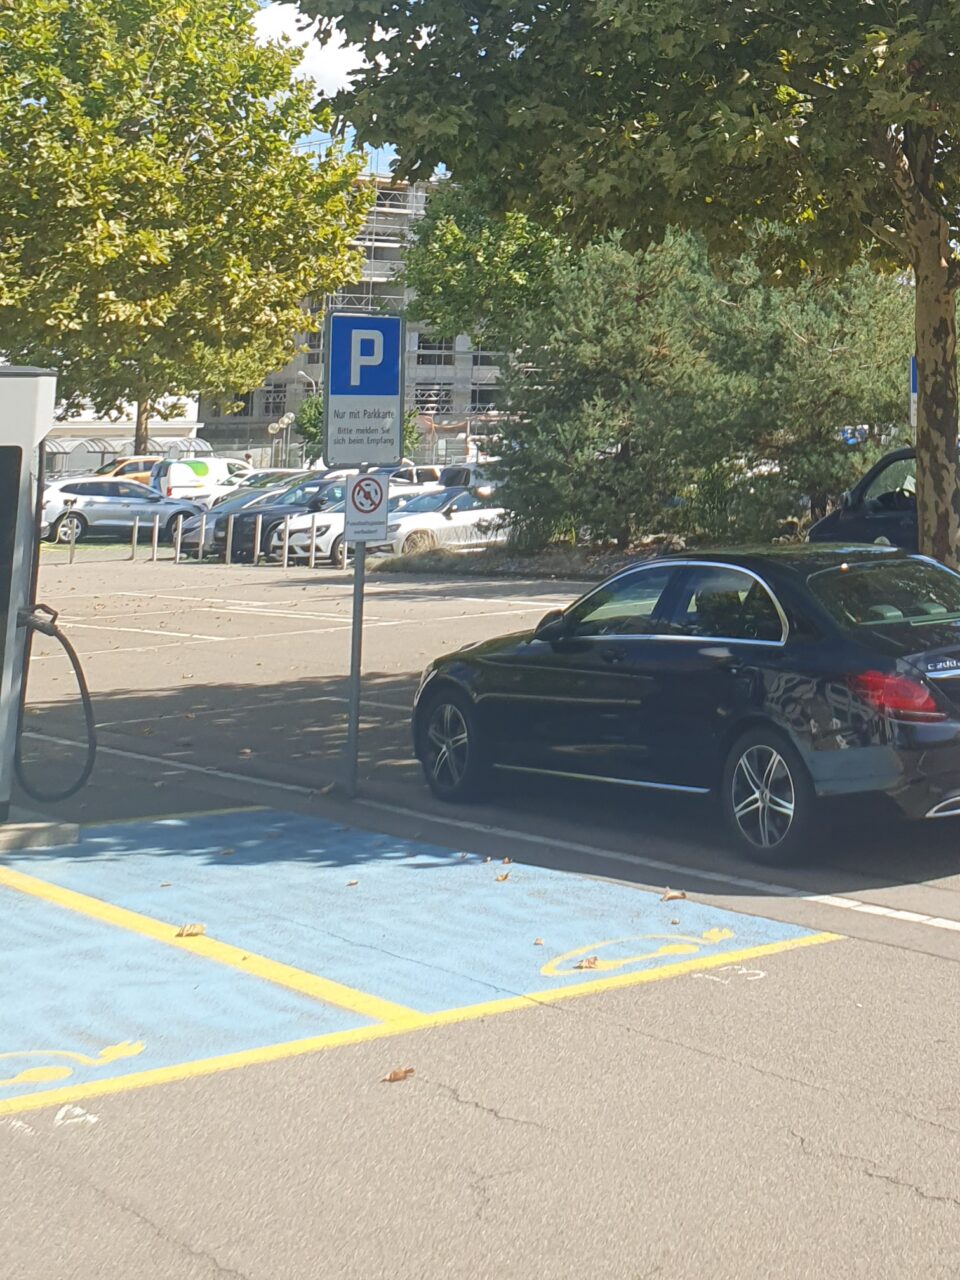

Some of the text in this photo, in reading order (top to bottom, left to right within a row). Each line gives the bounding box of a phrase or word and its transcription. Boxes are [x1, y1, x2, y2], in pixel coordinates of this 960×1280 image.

[350, 329, 384, 386] P
[333, 408, 395, 419] Nur mit Parkkarte
[337, 426, 391, 435] Bitte melden Sie
[333, 436, 395, 447] sich beim Empfang
